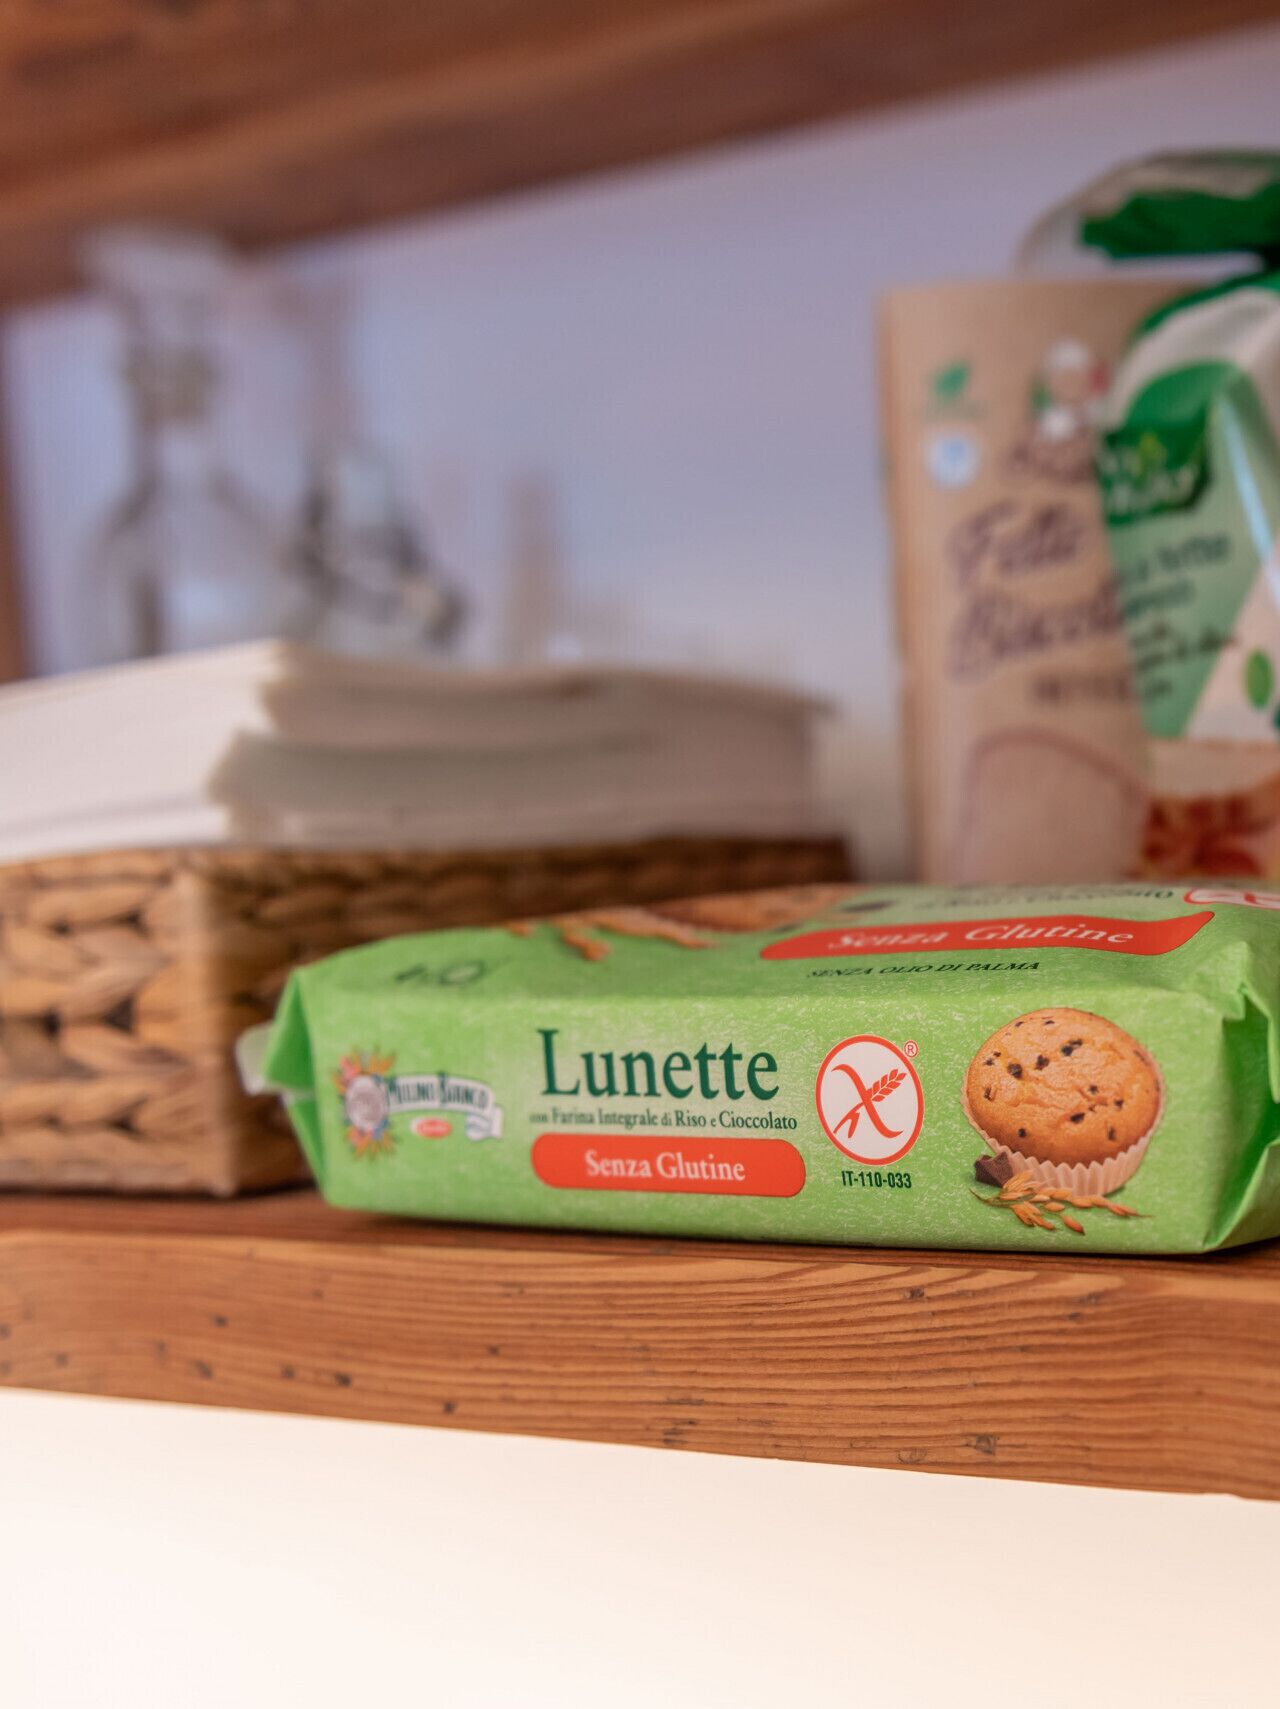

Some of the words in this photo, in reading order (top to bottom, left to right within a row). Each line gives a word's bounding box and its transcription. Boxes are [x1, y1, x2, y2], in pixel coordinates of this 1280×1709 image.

[828, 929, 949, 950] Senza
[963, 921, 1135, 945] Glutine
[807, 967, 873, 978] SENZA
[879, 964, 934, 975] OLIO
[934, 963, 966, 973] DI
[964, 961, 1040, 972] PALMA
[536, 1027, 780, 1102] Lunette
[551, 1107, 595, 1125] Farina
[598, 1107, 660, 1131] Integrale
[660, 1111, 672, 1127] di
[674, 1109, 707, 1128] Riso
[710, 1117, 717, 1128] e
[718, 1110, 798, 1130] Cioccolato
[584, 1148, 653, 1178] Senza
[655, 1151, 747, 1182] Glutine
[841, 1169, 913, 1189] IT-110-033
